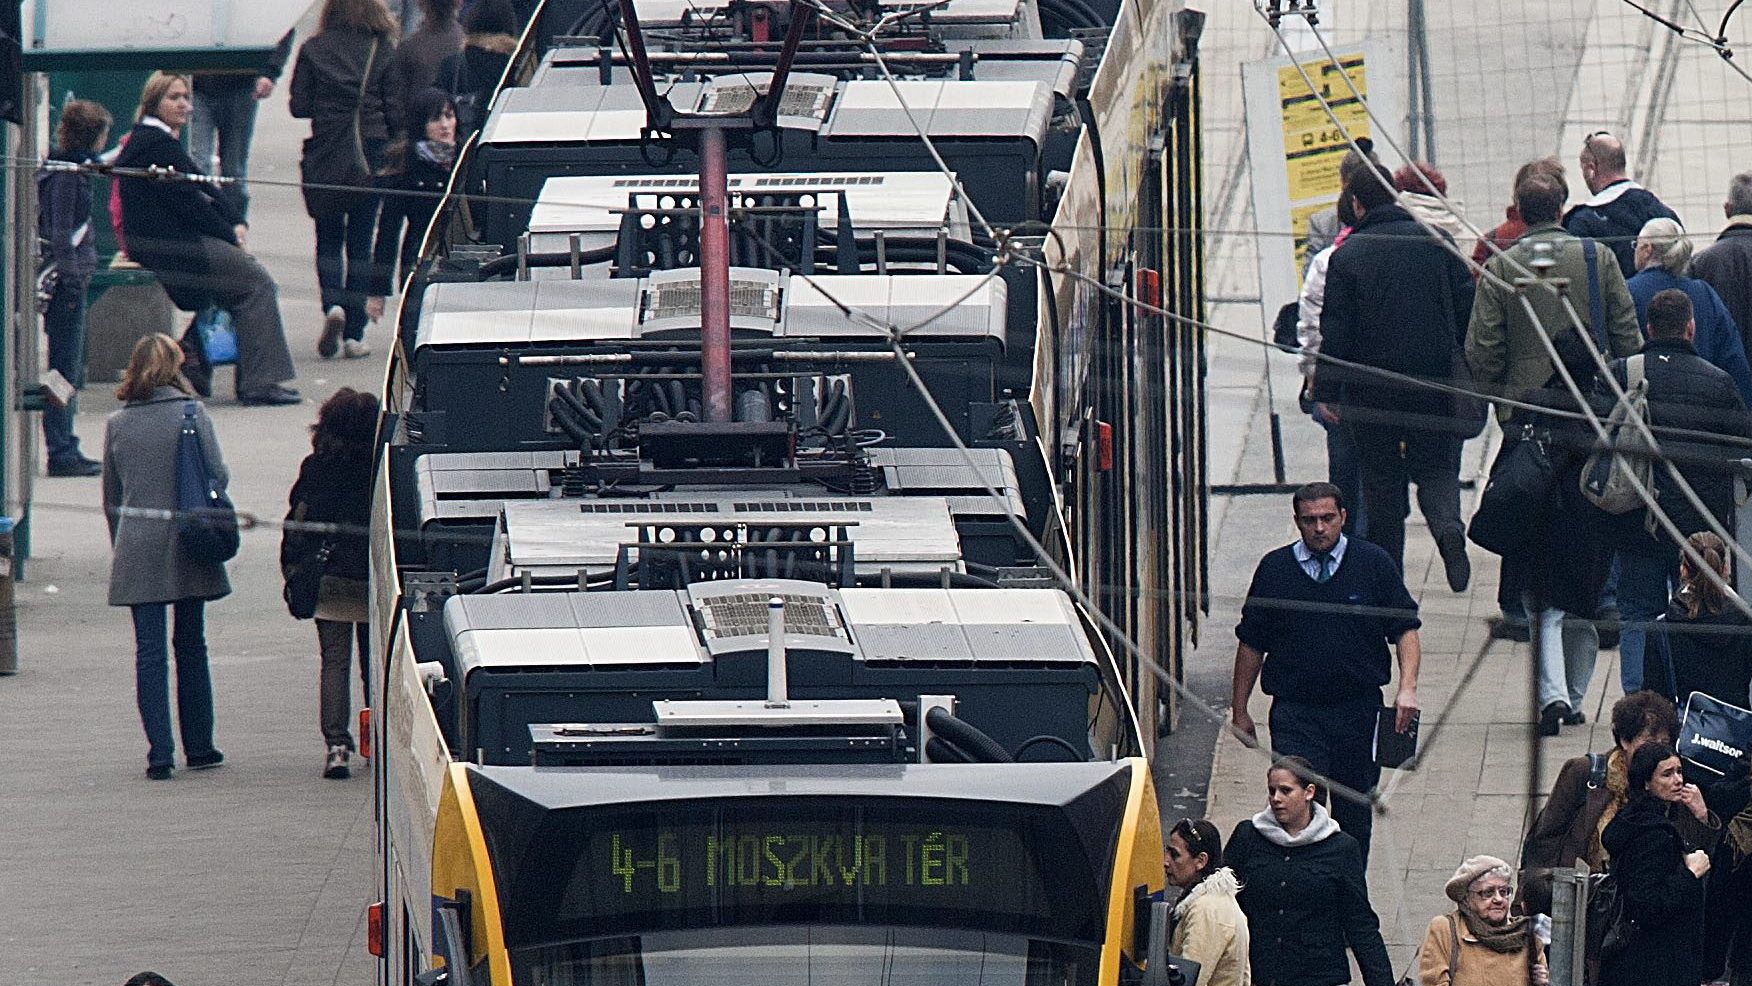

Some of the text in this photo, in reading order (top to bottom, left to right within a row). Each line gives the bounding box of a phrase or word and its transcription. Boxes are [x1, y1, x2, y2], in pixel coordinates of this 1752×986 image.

[611, 832, 970, 893] 4-6 MOSZKVA TÉR
